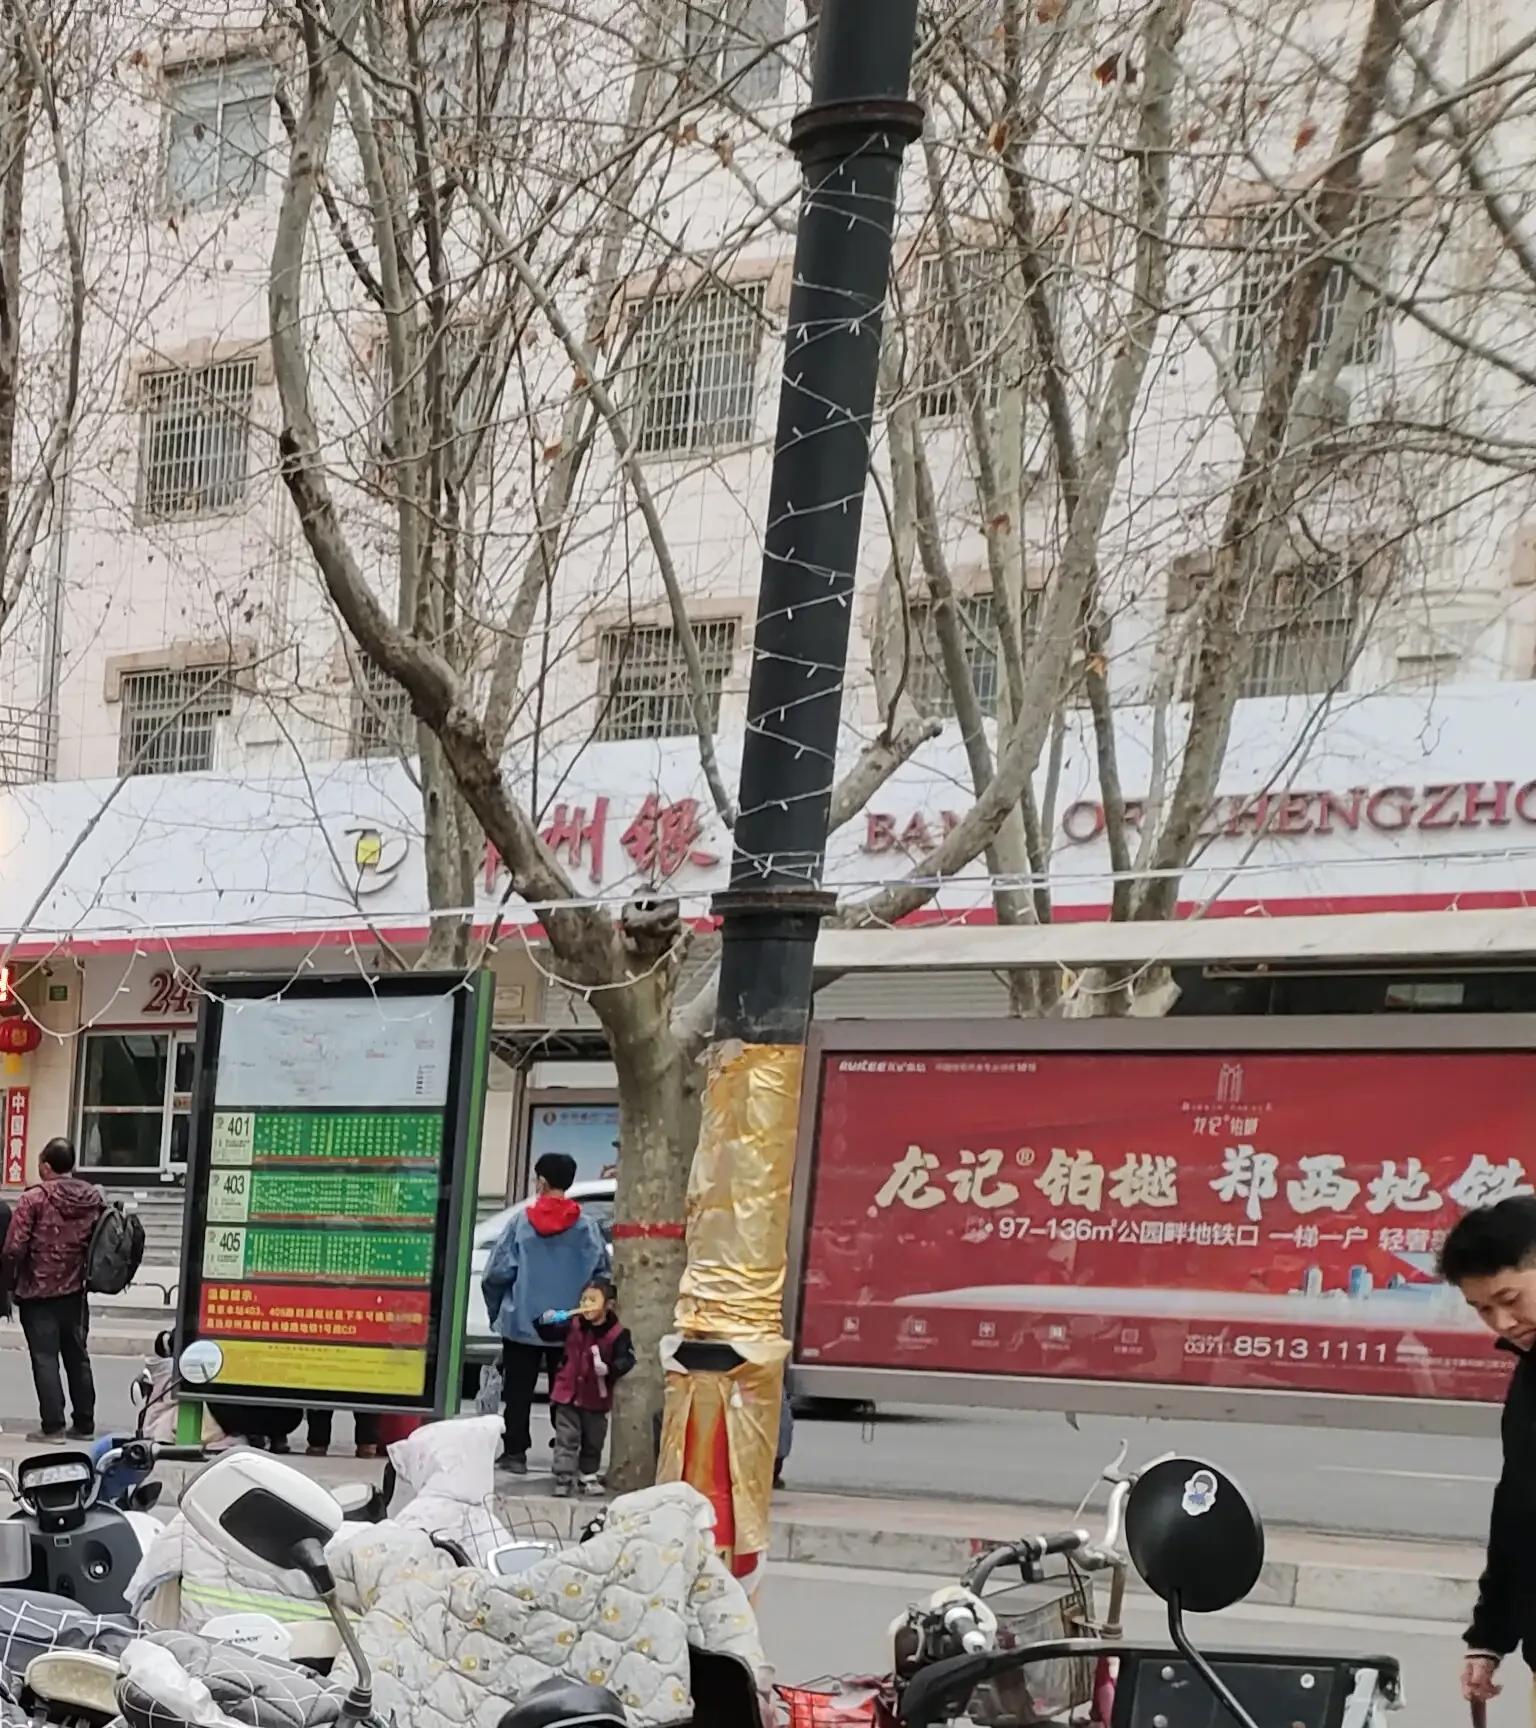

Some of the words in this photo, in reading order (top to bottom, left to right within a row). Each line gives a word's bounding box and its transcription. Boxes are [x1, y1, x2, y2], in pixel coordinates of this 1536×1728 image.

[227, 1117, 251, 1136] 401
[8, 1091, 26, 1183] 中国黄金
[223, 1174, 245, 1195] 403
[219, 1233, 241, 1252] 405
